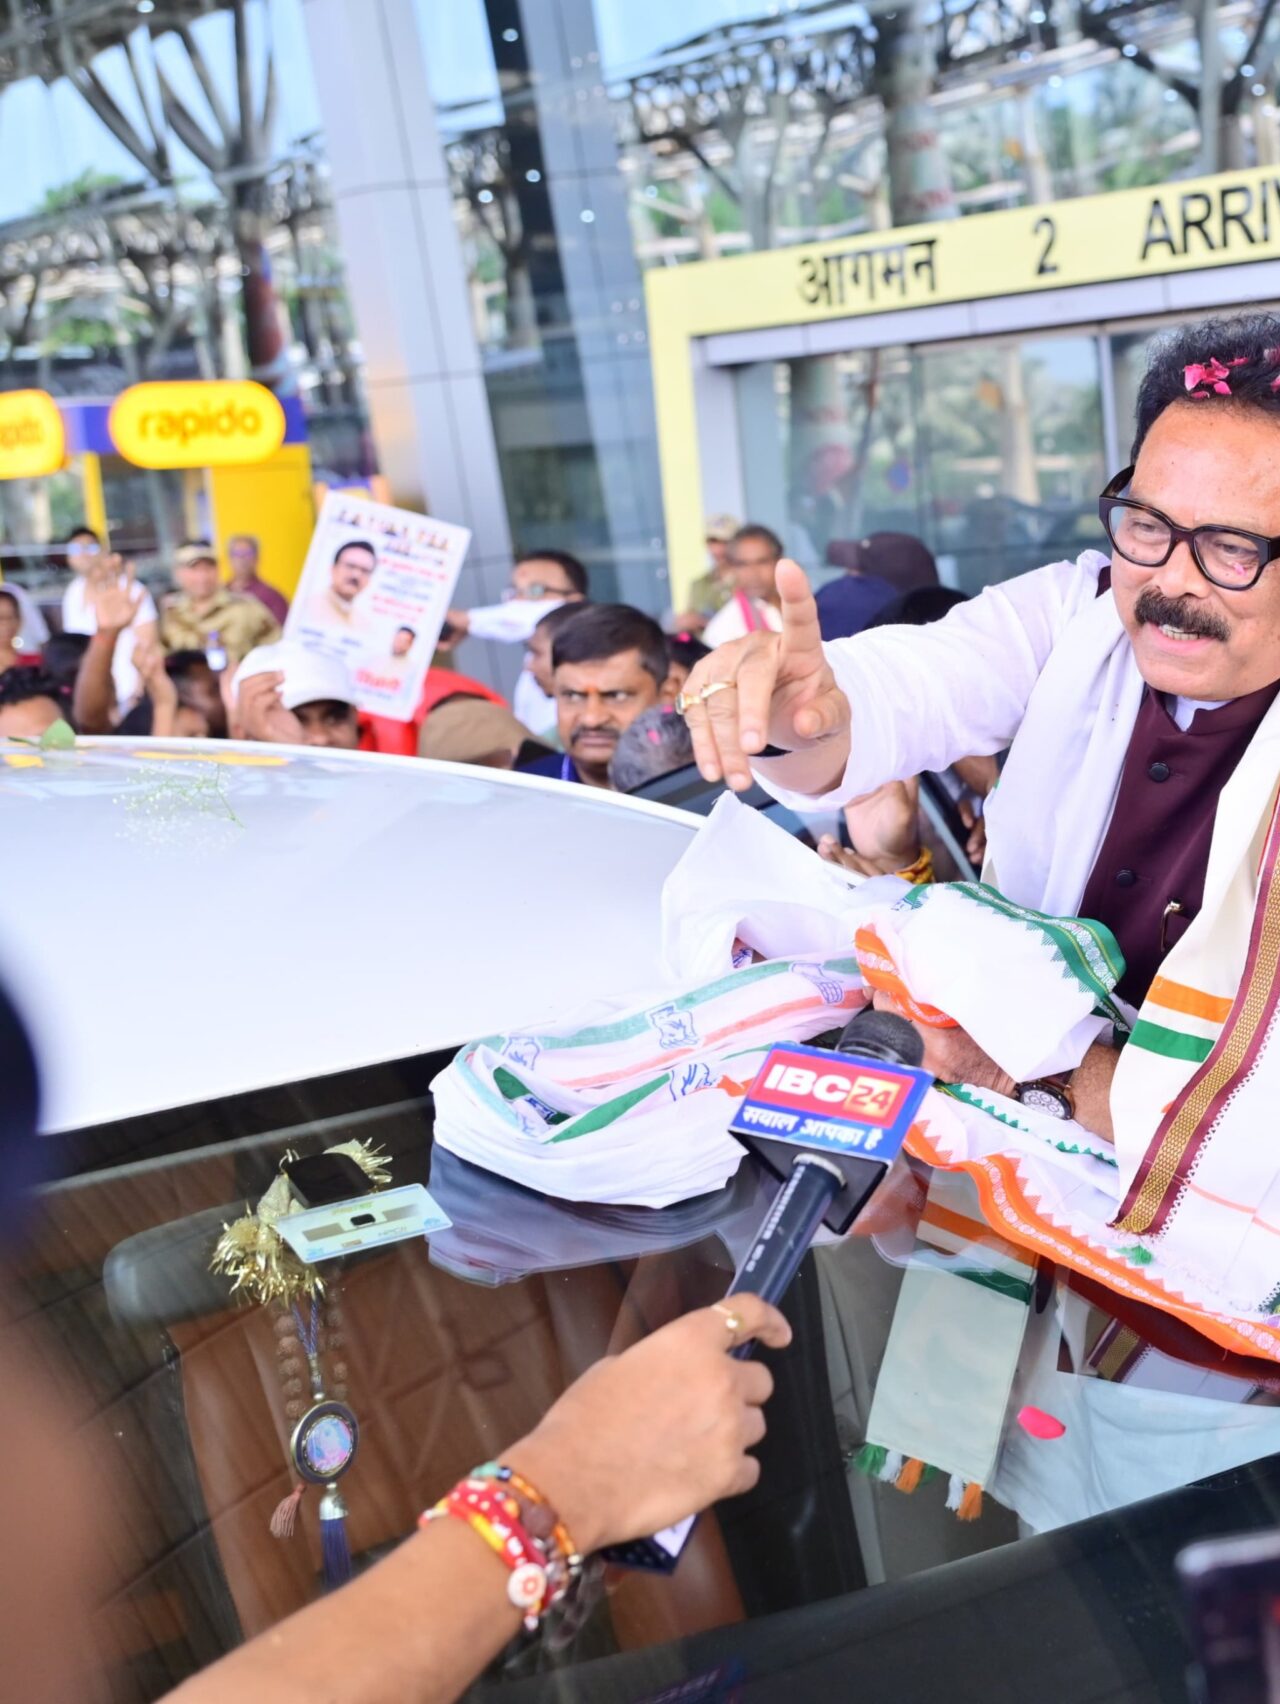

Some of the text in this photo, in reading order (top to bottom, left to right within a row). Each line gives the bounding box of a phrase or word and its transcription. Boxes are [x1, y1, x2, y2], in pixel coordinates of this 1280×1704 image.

[1031, 215, 1061, 276] 2
[797, 236, 938, 309] आगमन
[138, 399, 262, 448] rapido
[764, 1064, 893, 1111] IBC24
[742, 1105, 884, 1151] सवाल आपका है
